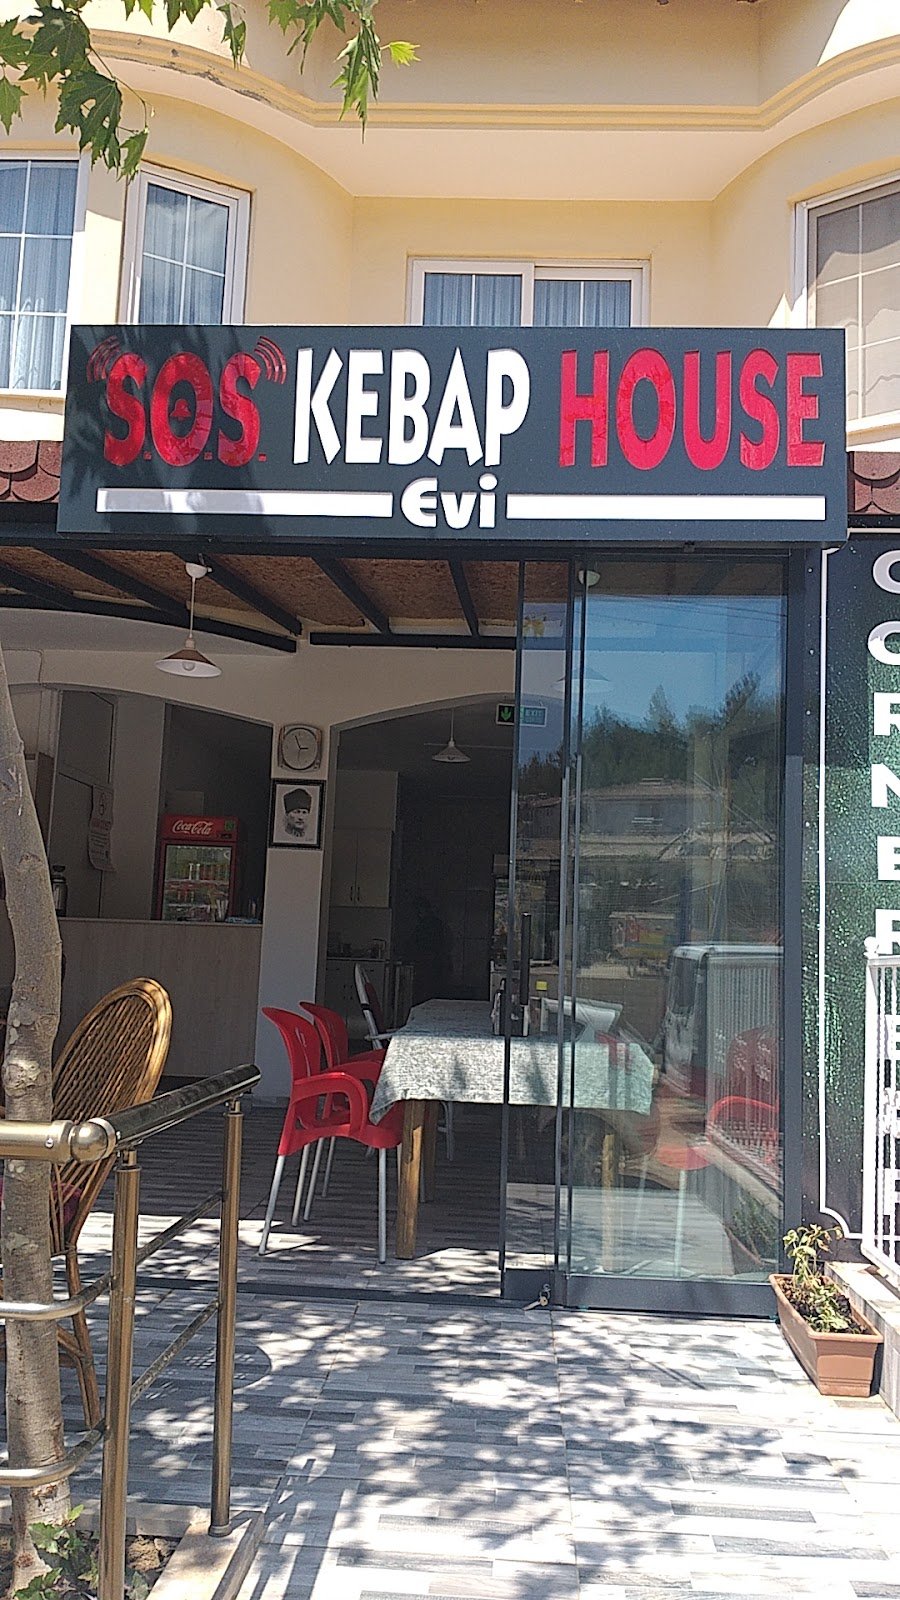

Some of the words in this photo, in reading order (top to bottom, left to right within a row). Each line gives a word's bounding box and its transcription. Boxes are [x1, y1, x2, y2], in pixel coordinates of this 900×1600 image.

[293, 347, 530, 466] KEBAP
[559, 348, 826, 470] HOUSE
[401, 473, 497, 529] Evi
